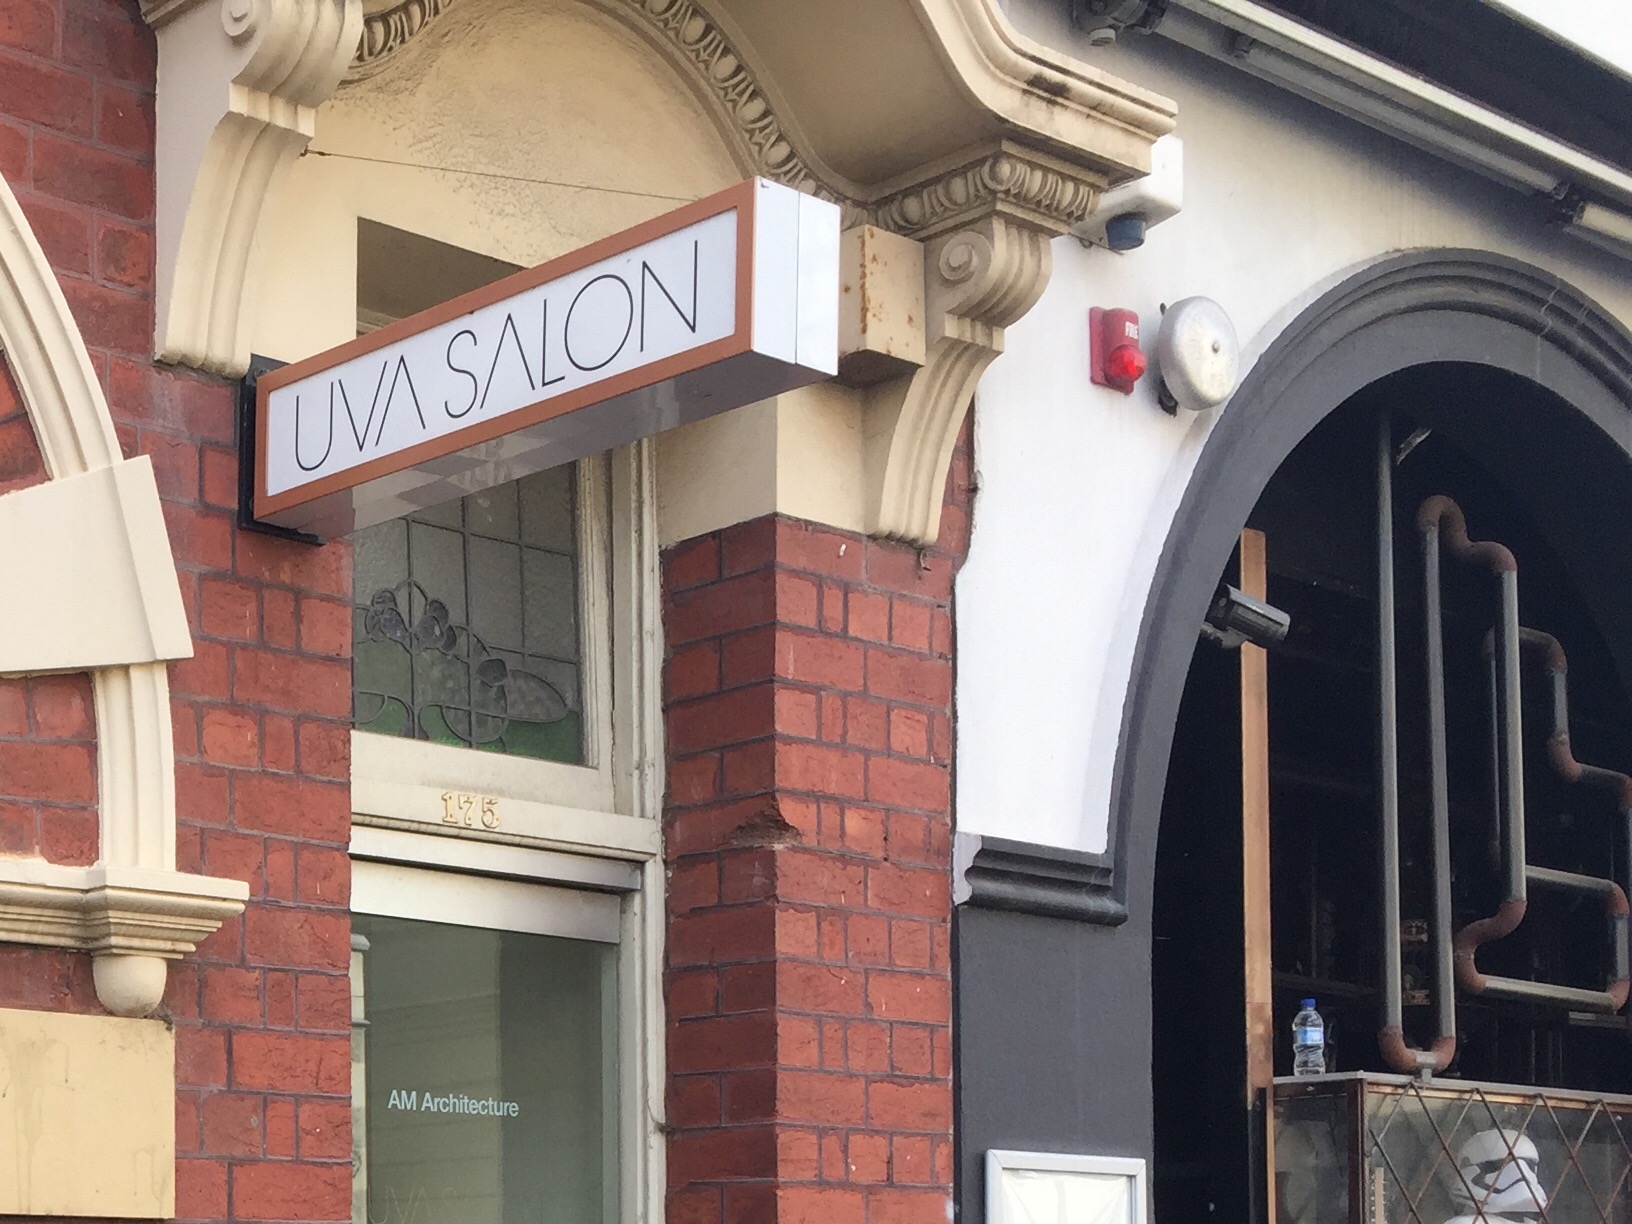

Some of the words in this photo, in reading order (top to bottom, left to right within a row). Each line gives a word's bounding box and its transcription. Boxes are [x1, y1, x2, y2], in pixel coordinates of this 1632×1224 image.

[294, 355, 426, 473] UVA
[444, 239, 699, 419] SALON
[440, 790, 501, 830] 175
[387, 1088, 417, 1112] AM
[420, 1090, 519, 1117] Architecture
